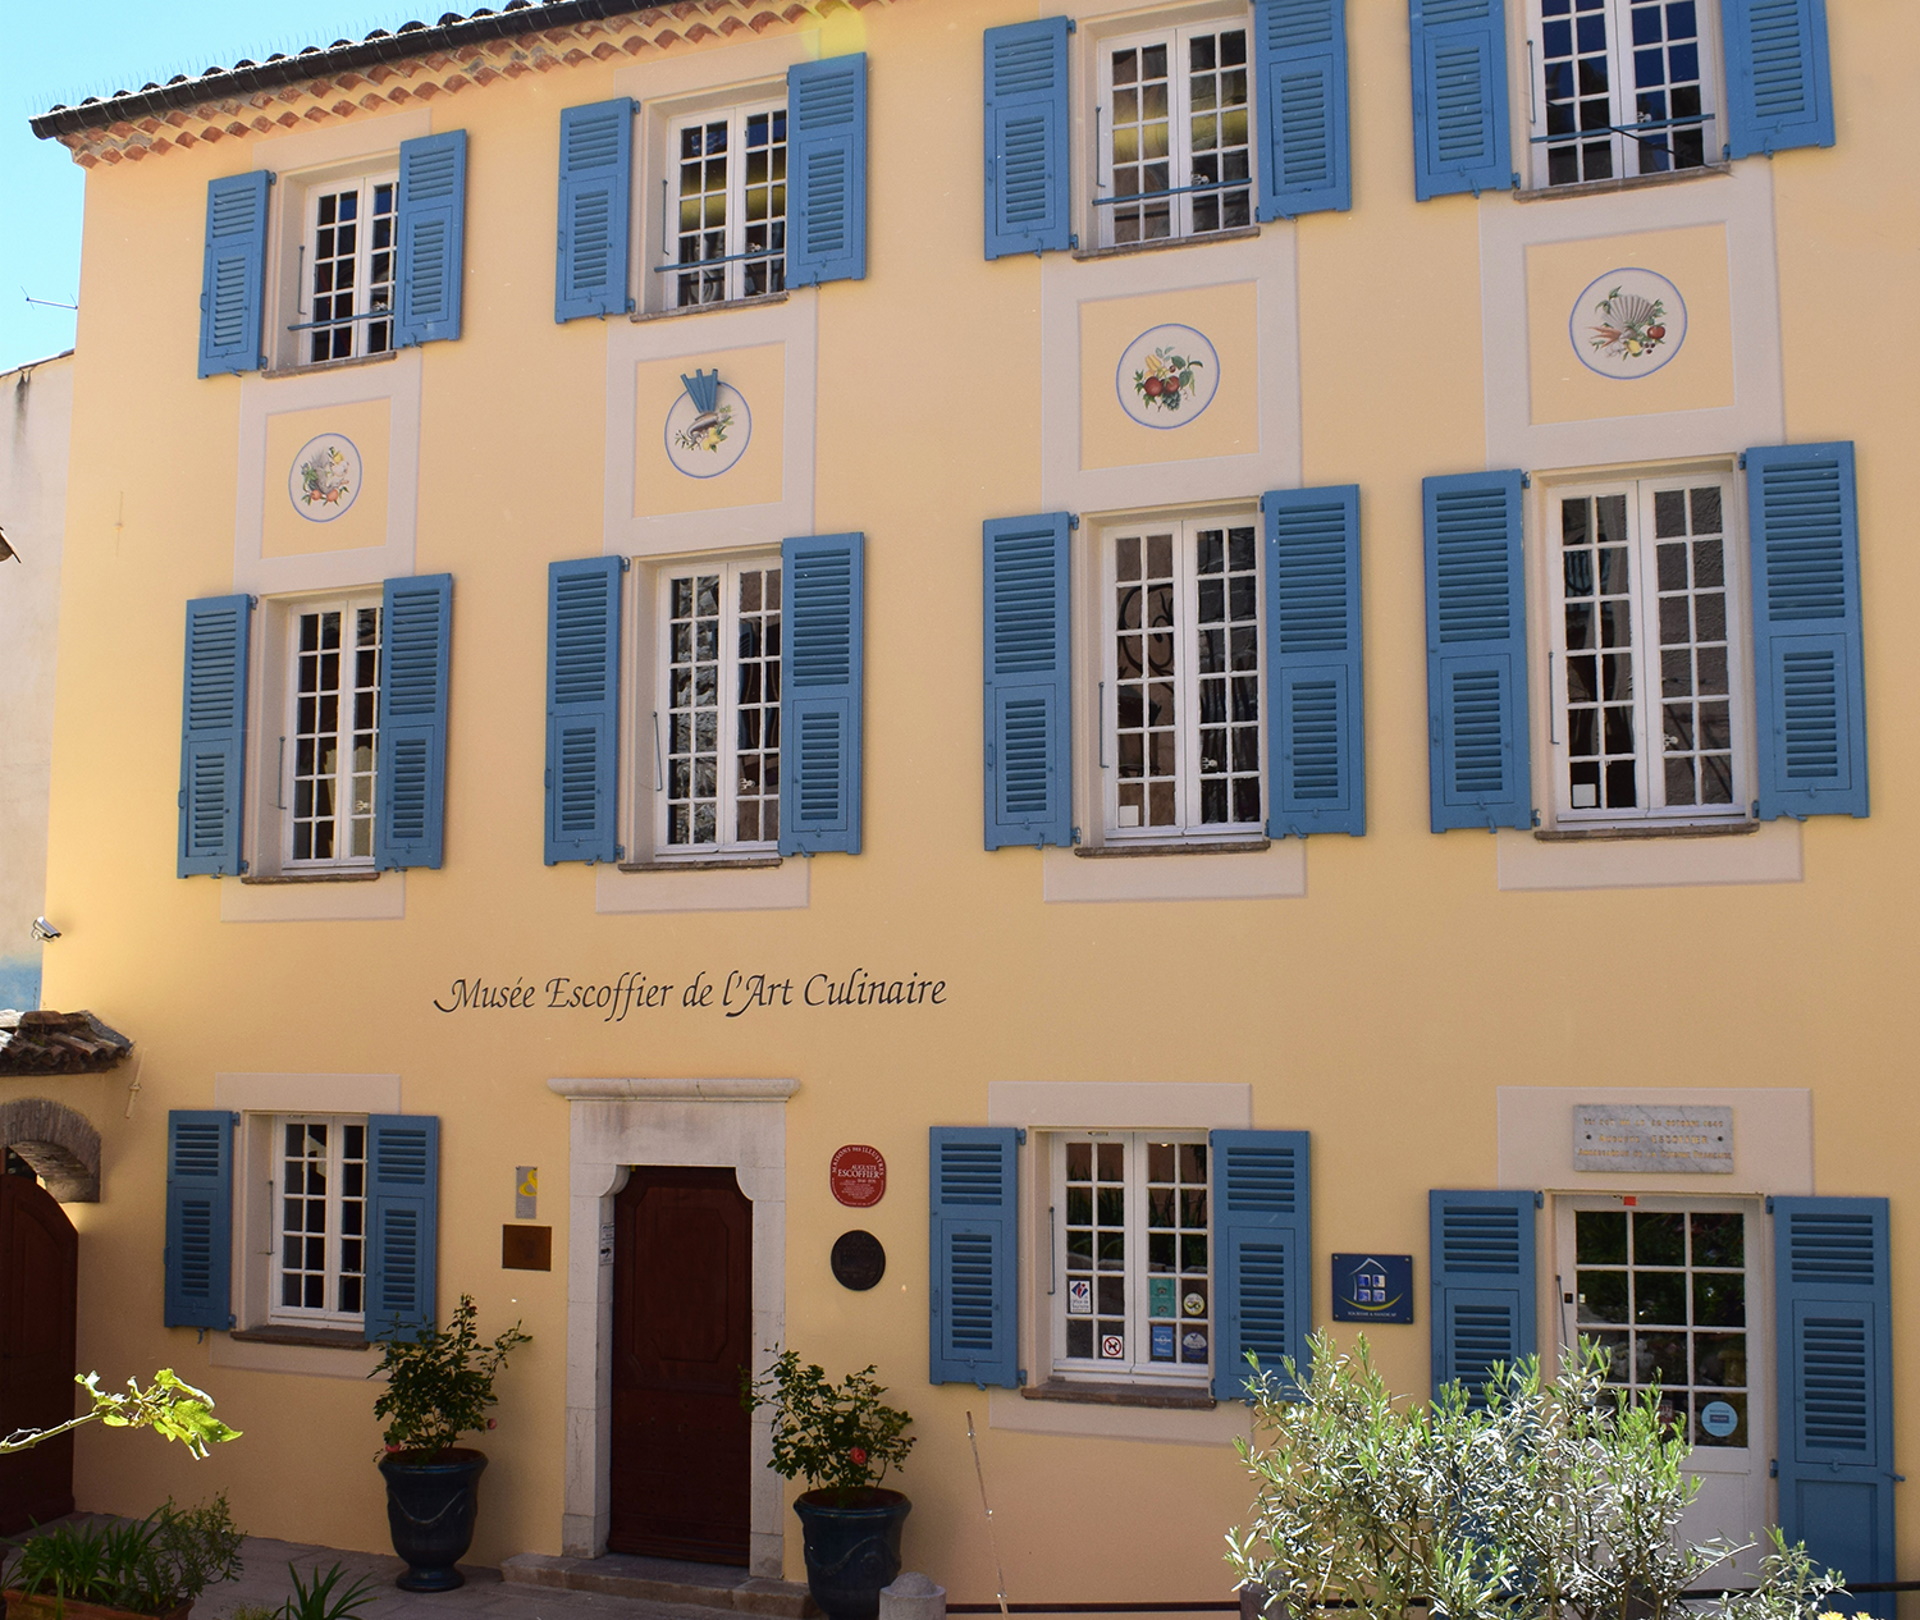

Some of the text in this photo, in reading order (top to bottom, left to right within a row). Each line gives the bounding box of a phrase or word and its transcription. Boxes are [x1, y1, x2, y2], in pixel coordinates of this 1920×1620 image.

[434, 976, 536, 1013] Musée
[545, 971, 674, 1022] Escoffier
[682, 970, 714, 1008] de
[803, 967, 948, 1006] Culinaire
[832, 1147, 851, 1173] MAISONS
[862, 1147, 884, 1175] ILLUSTRES
[837, 1168, 880, 1178] ESCOFFIER
